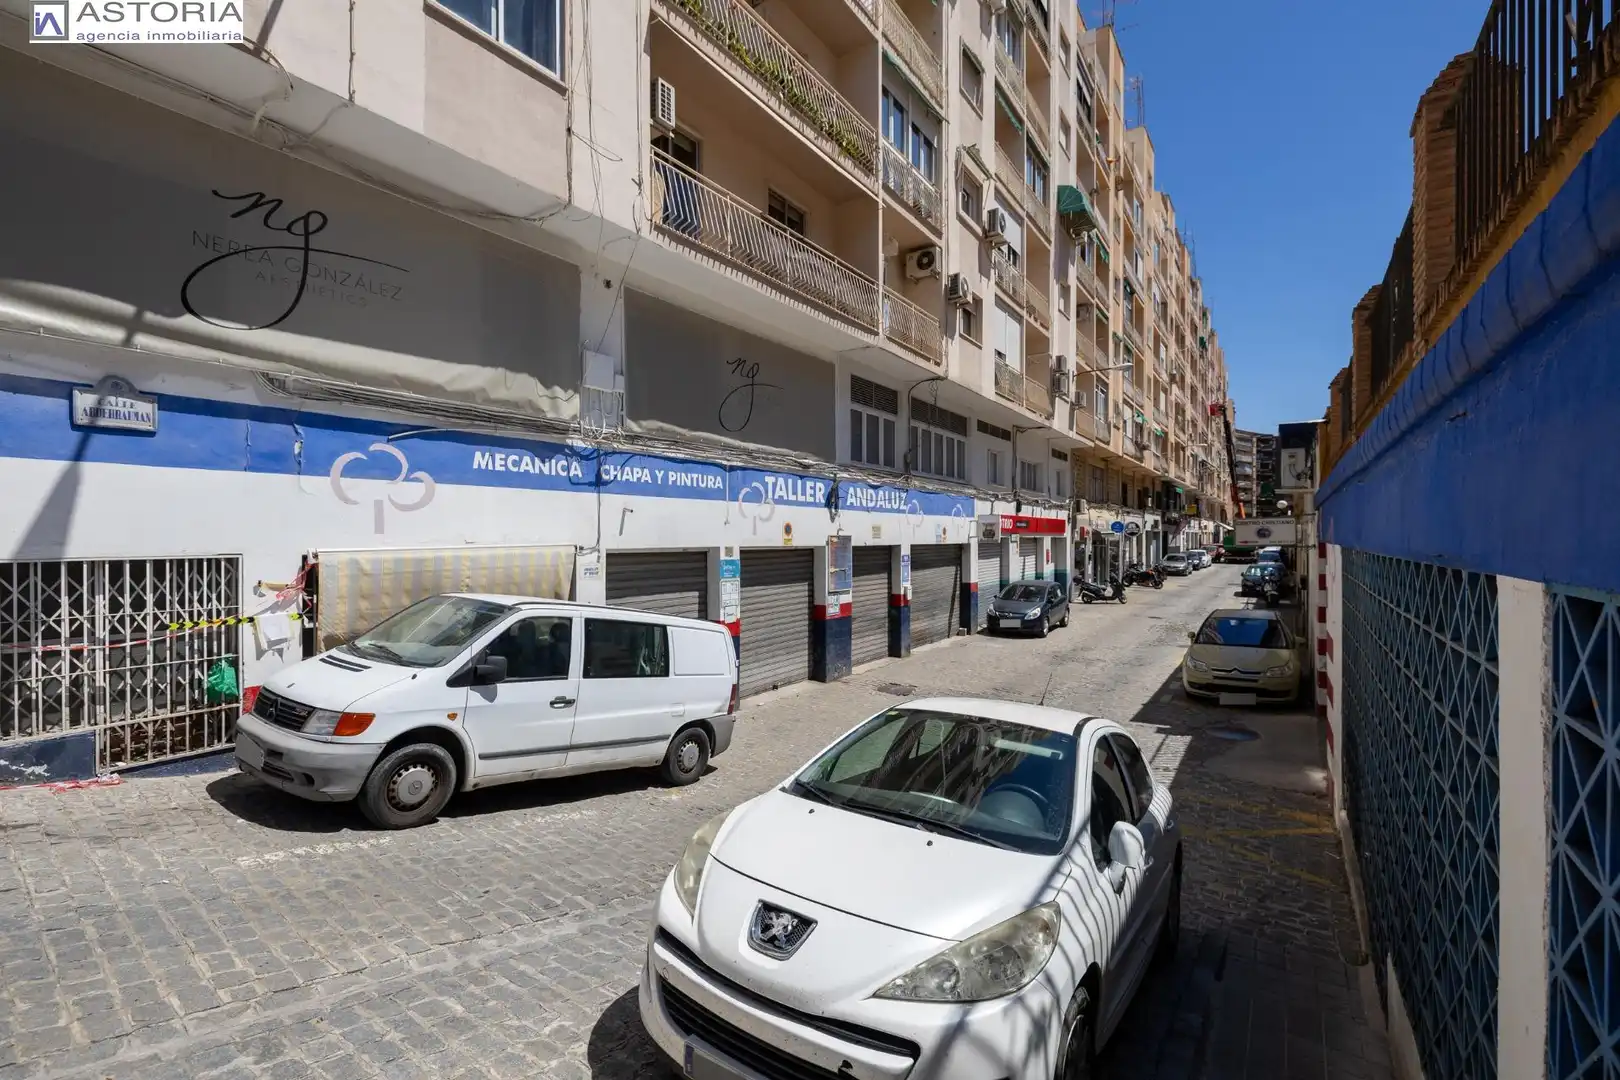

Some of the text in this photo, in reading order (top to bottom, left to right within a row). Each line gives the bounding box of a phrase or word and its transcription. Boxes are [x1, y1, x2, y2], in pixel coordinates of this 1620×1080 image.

[192, 230, 402, 301] NEREA GONZÁLEZ
[472, 451, 583, 478] MECANICA
[600, 464, 724, 490] CHAPA Y PINTURA
[764, 475, 908, 510] TALLER ANDALUZ
